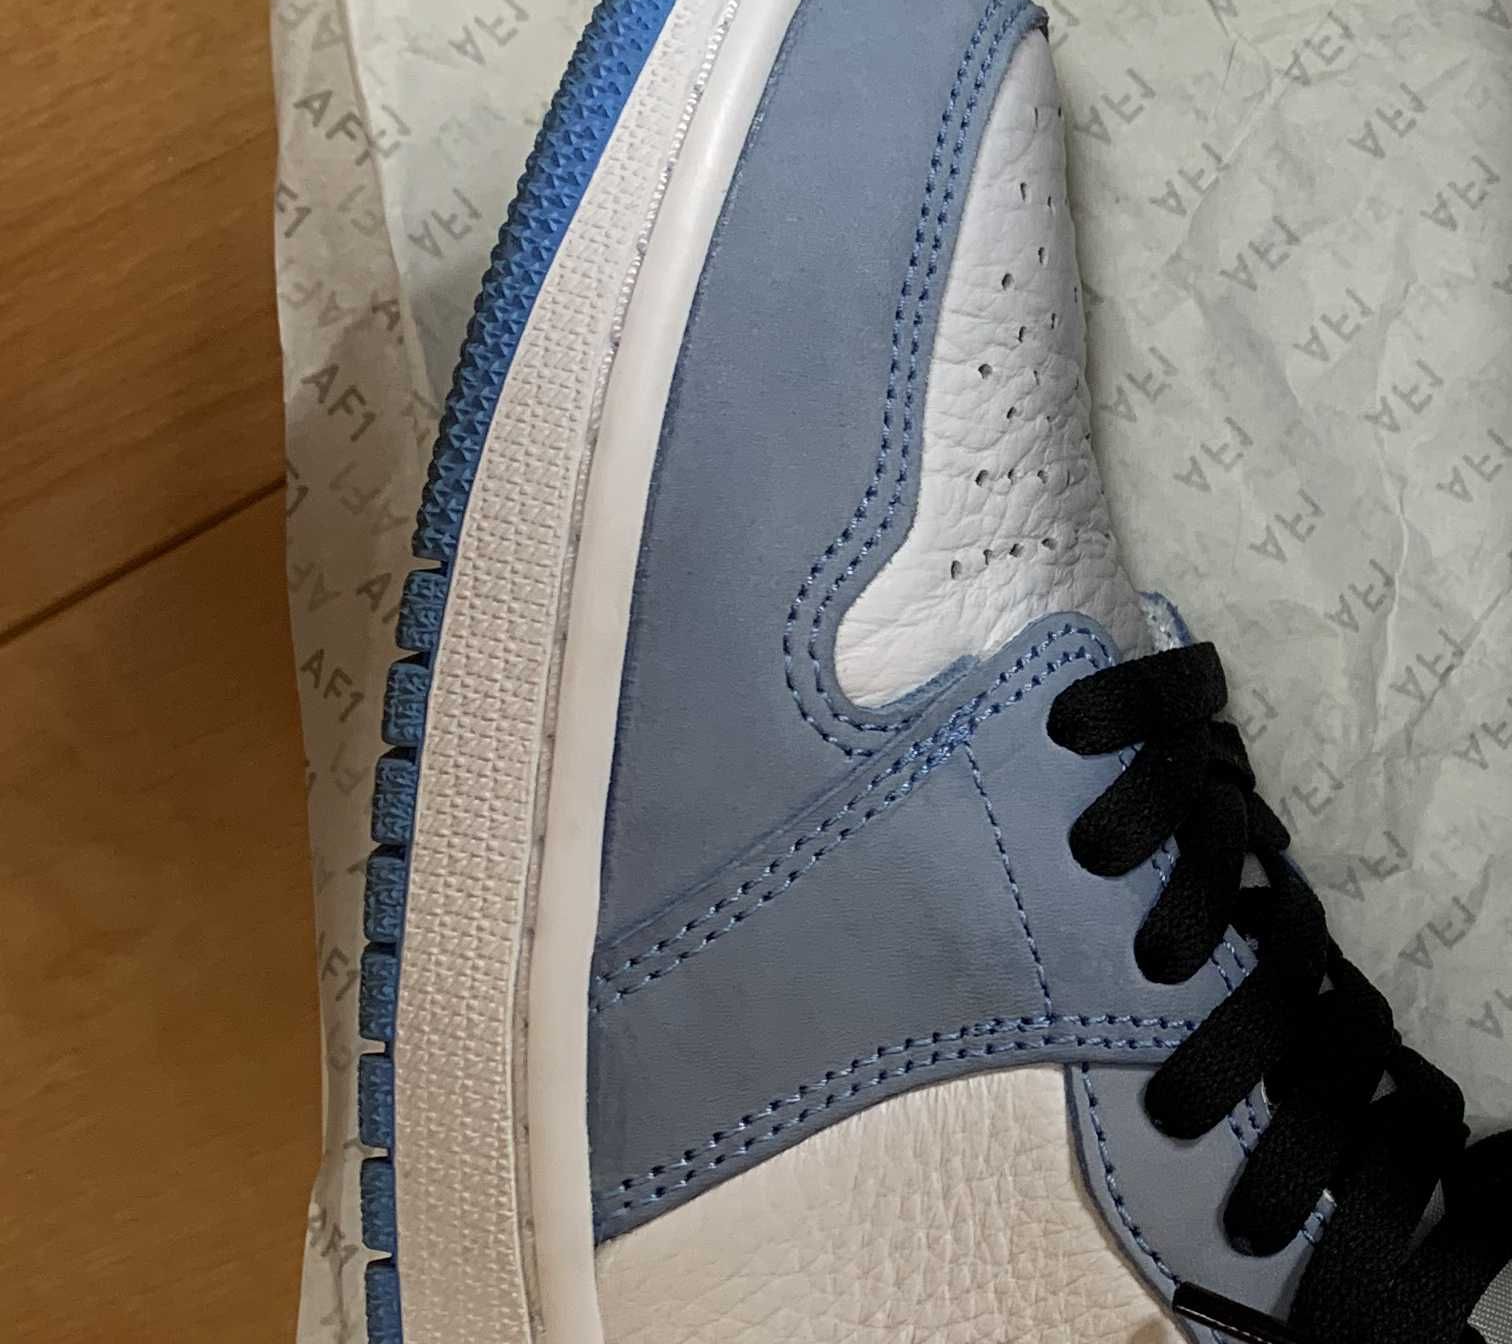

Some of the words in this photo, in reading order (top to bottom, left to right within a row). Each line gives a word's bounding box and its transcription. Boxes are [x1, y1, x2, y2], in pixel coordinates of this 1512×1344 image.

[293, 89, 374, 167] AF1
[270, 181, 313, 239] F1
[301, 363, 376, 443] AF1
[301, 648, 365, 723] AF1
